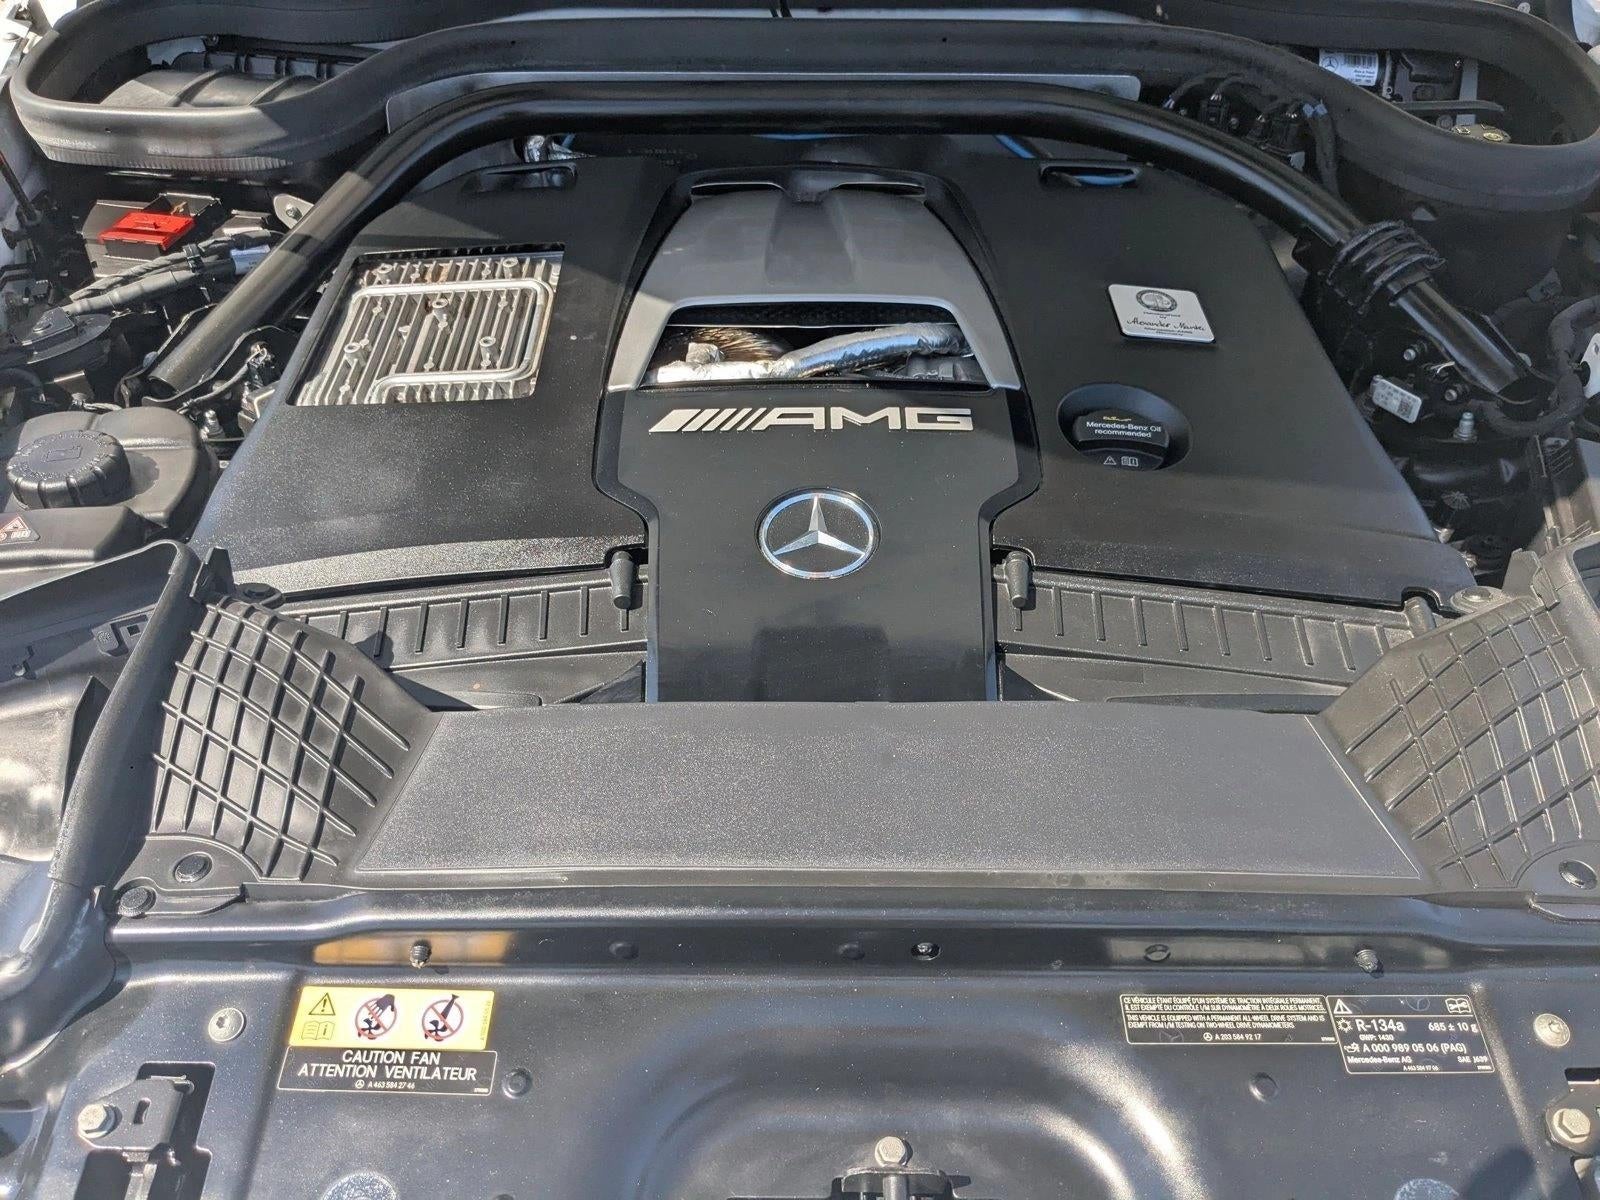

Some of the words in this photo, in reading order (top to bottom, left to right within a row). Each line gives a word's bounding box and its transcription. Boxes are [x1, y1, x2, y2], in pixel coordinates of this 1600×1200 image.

[752, 407, 973, 431] AMG
[1086, 422, 1148, 432] Mercedes-Benz
[1094, 428, 1152, 438] recommended
[1355, 1019, 1406, 1032] R-134a
[1428, 1022, 1446, 1031] 685
[1457, 1022, 1468, 1031] 10
[1470, 1024, 1478, 1033] g
[1363, 1043, 1370, 1052] A
[1371, 1043, 1390, 1052] 000
[1391, 1043, 1410, 1052] 989
[1412, 1043, 1424, 1052] 05
[1426, 1043, 1439, 1052] 06
[1440, 1043, 1467, 1054] (PAG)
[342, 1050, 405, 1064] CAUTION
[410, 1052, 441, 1065] FAN
[297, 1063, 377, 1078] ATTENTION
[385, 1065, 477, 1081] VENTILATEUR
